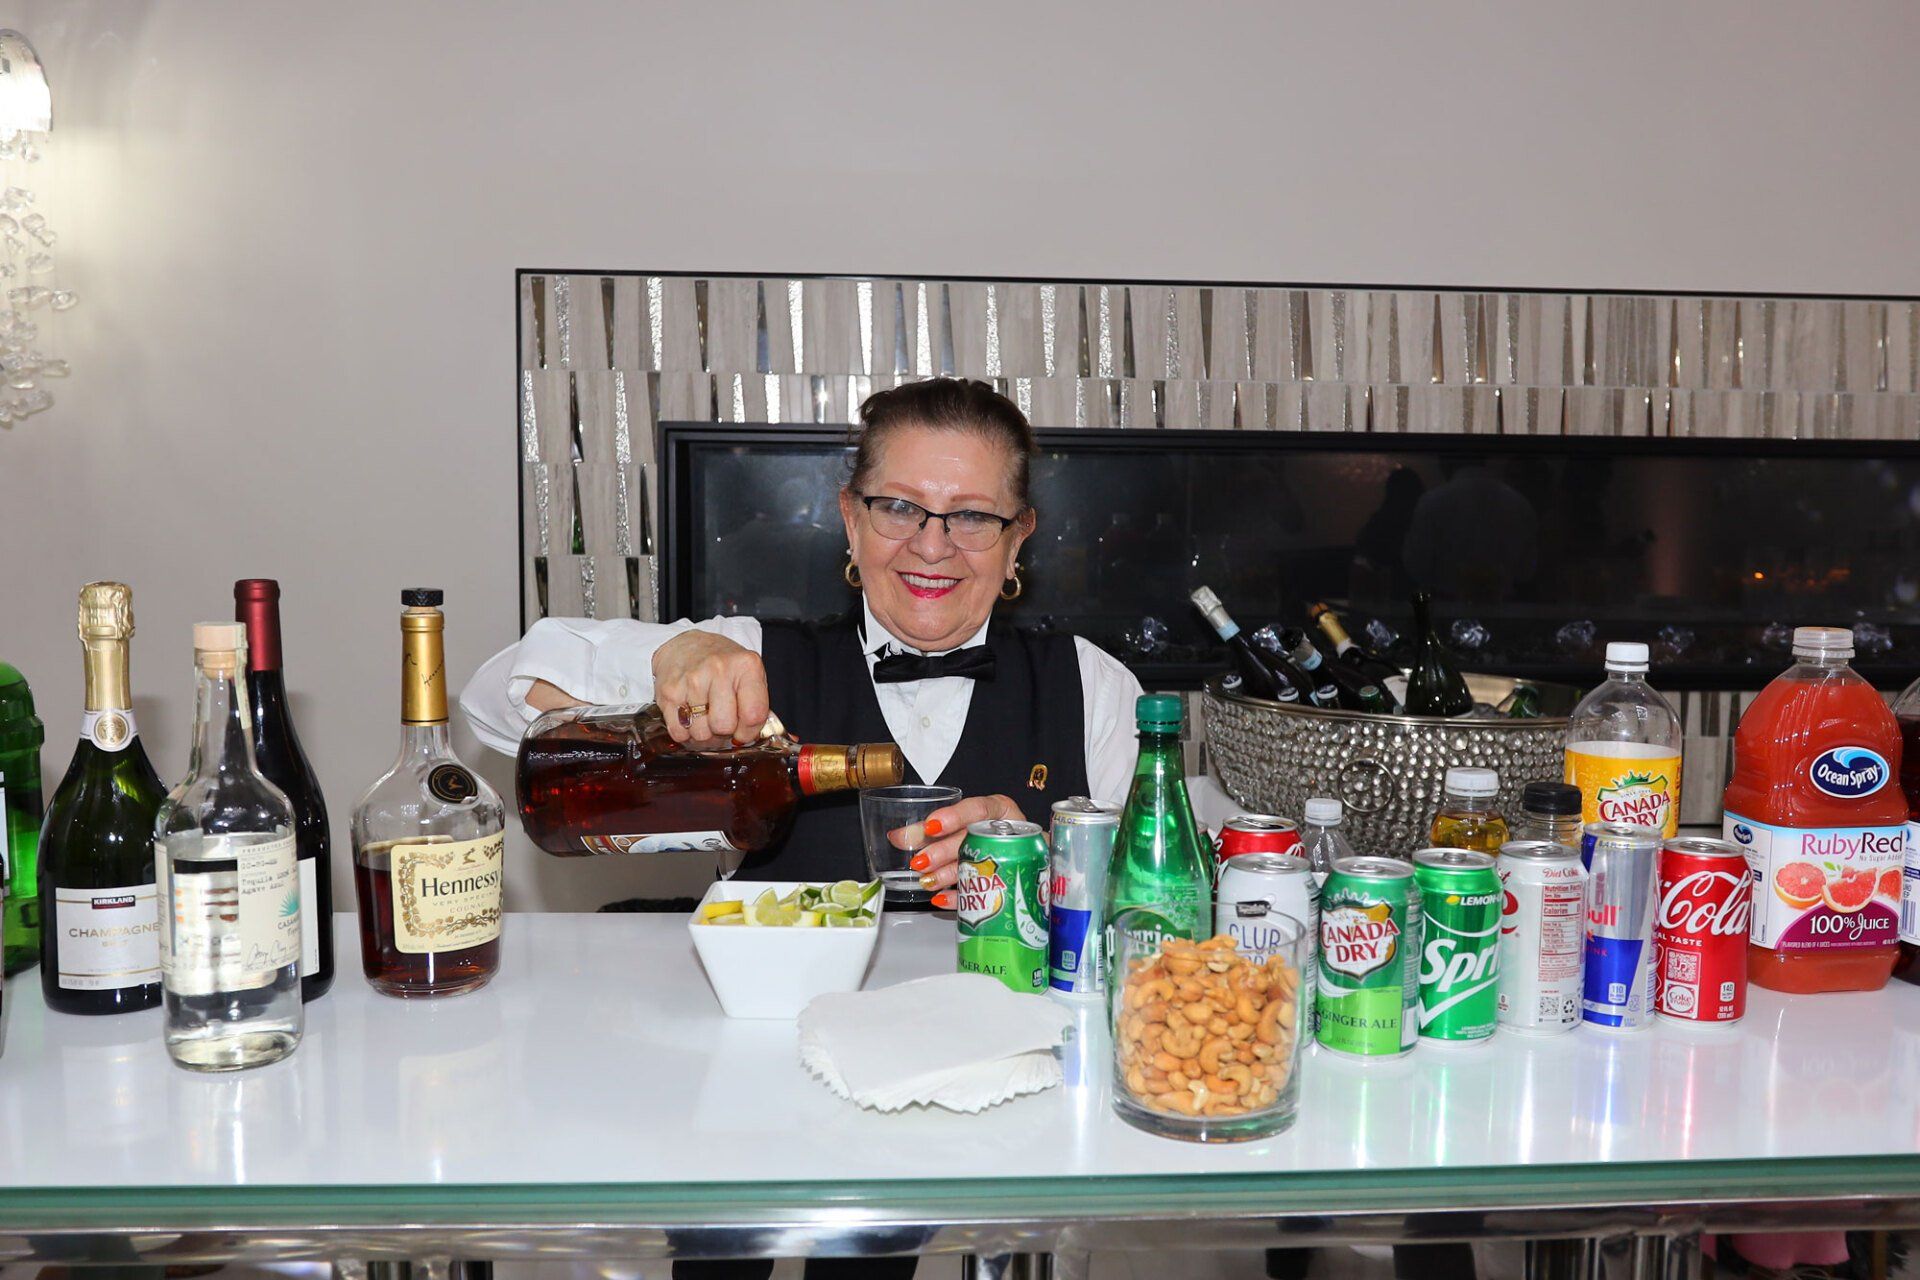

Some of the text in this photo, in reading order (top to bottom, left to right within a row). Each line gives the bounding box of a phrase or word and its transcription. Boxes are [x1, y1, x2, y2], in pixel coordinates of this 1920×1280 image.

[1817, 764, 1880, 789] Ocean Spray
[1599, 791, 1671, 822] CANADA
[1543, 868, 1562, 877] Diet
[421, 870, 499, 897] Hennessy
[958, 874, 1007, 895] NADA
[93, 896, 135, 905] KIRKLAND
[449, 902, 486, 914] COGNAC
[959, 894, 987, 913] DRY
[1587, 904, 1617, 927] ull
[1809, 914, 1856, 935] 100%
[68, 921, 160, 938] CHAMPAGNE
[1229, 923, 1281, 955] CLUB
[1321, 918, 1401, 949] CANADA
[1670, 935, 1703, 947] TASTE
[1336, 942, 1379, 963] DRY
[983, 964, 1007, 975] ALE
[1420, 939, 1500, 993] Spri
[1611, 985, 1624, 994] 110
[1669, 991, 1691, 1002] Coke
[1722, 984, 1734, 992] 140
[1322, 1010, 1398, 1029] GINGER ALE
